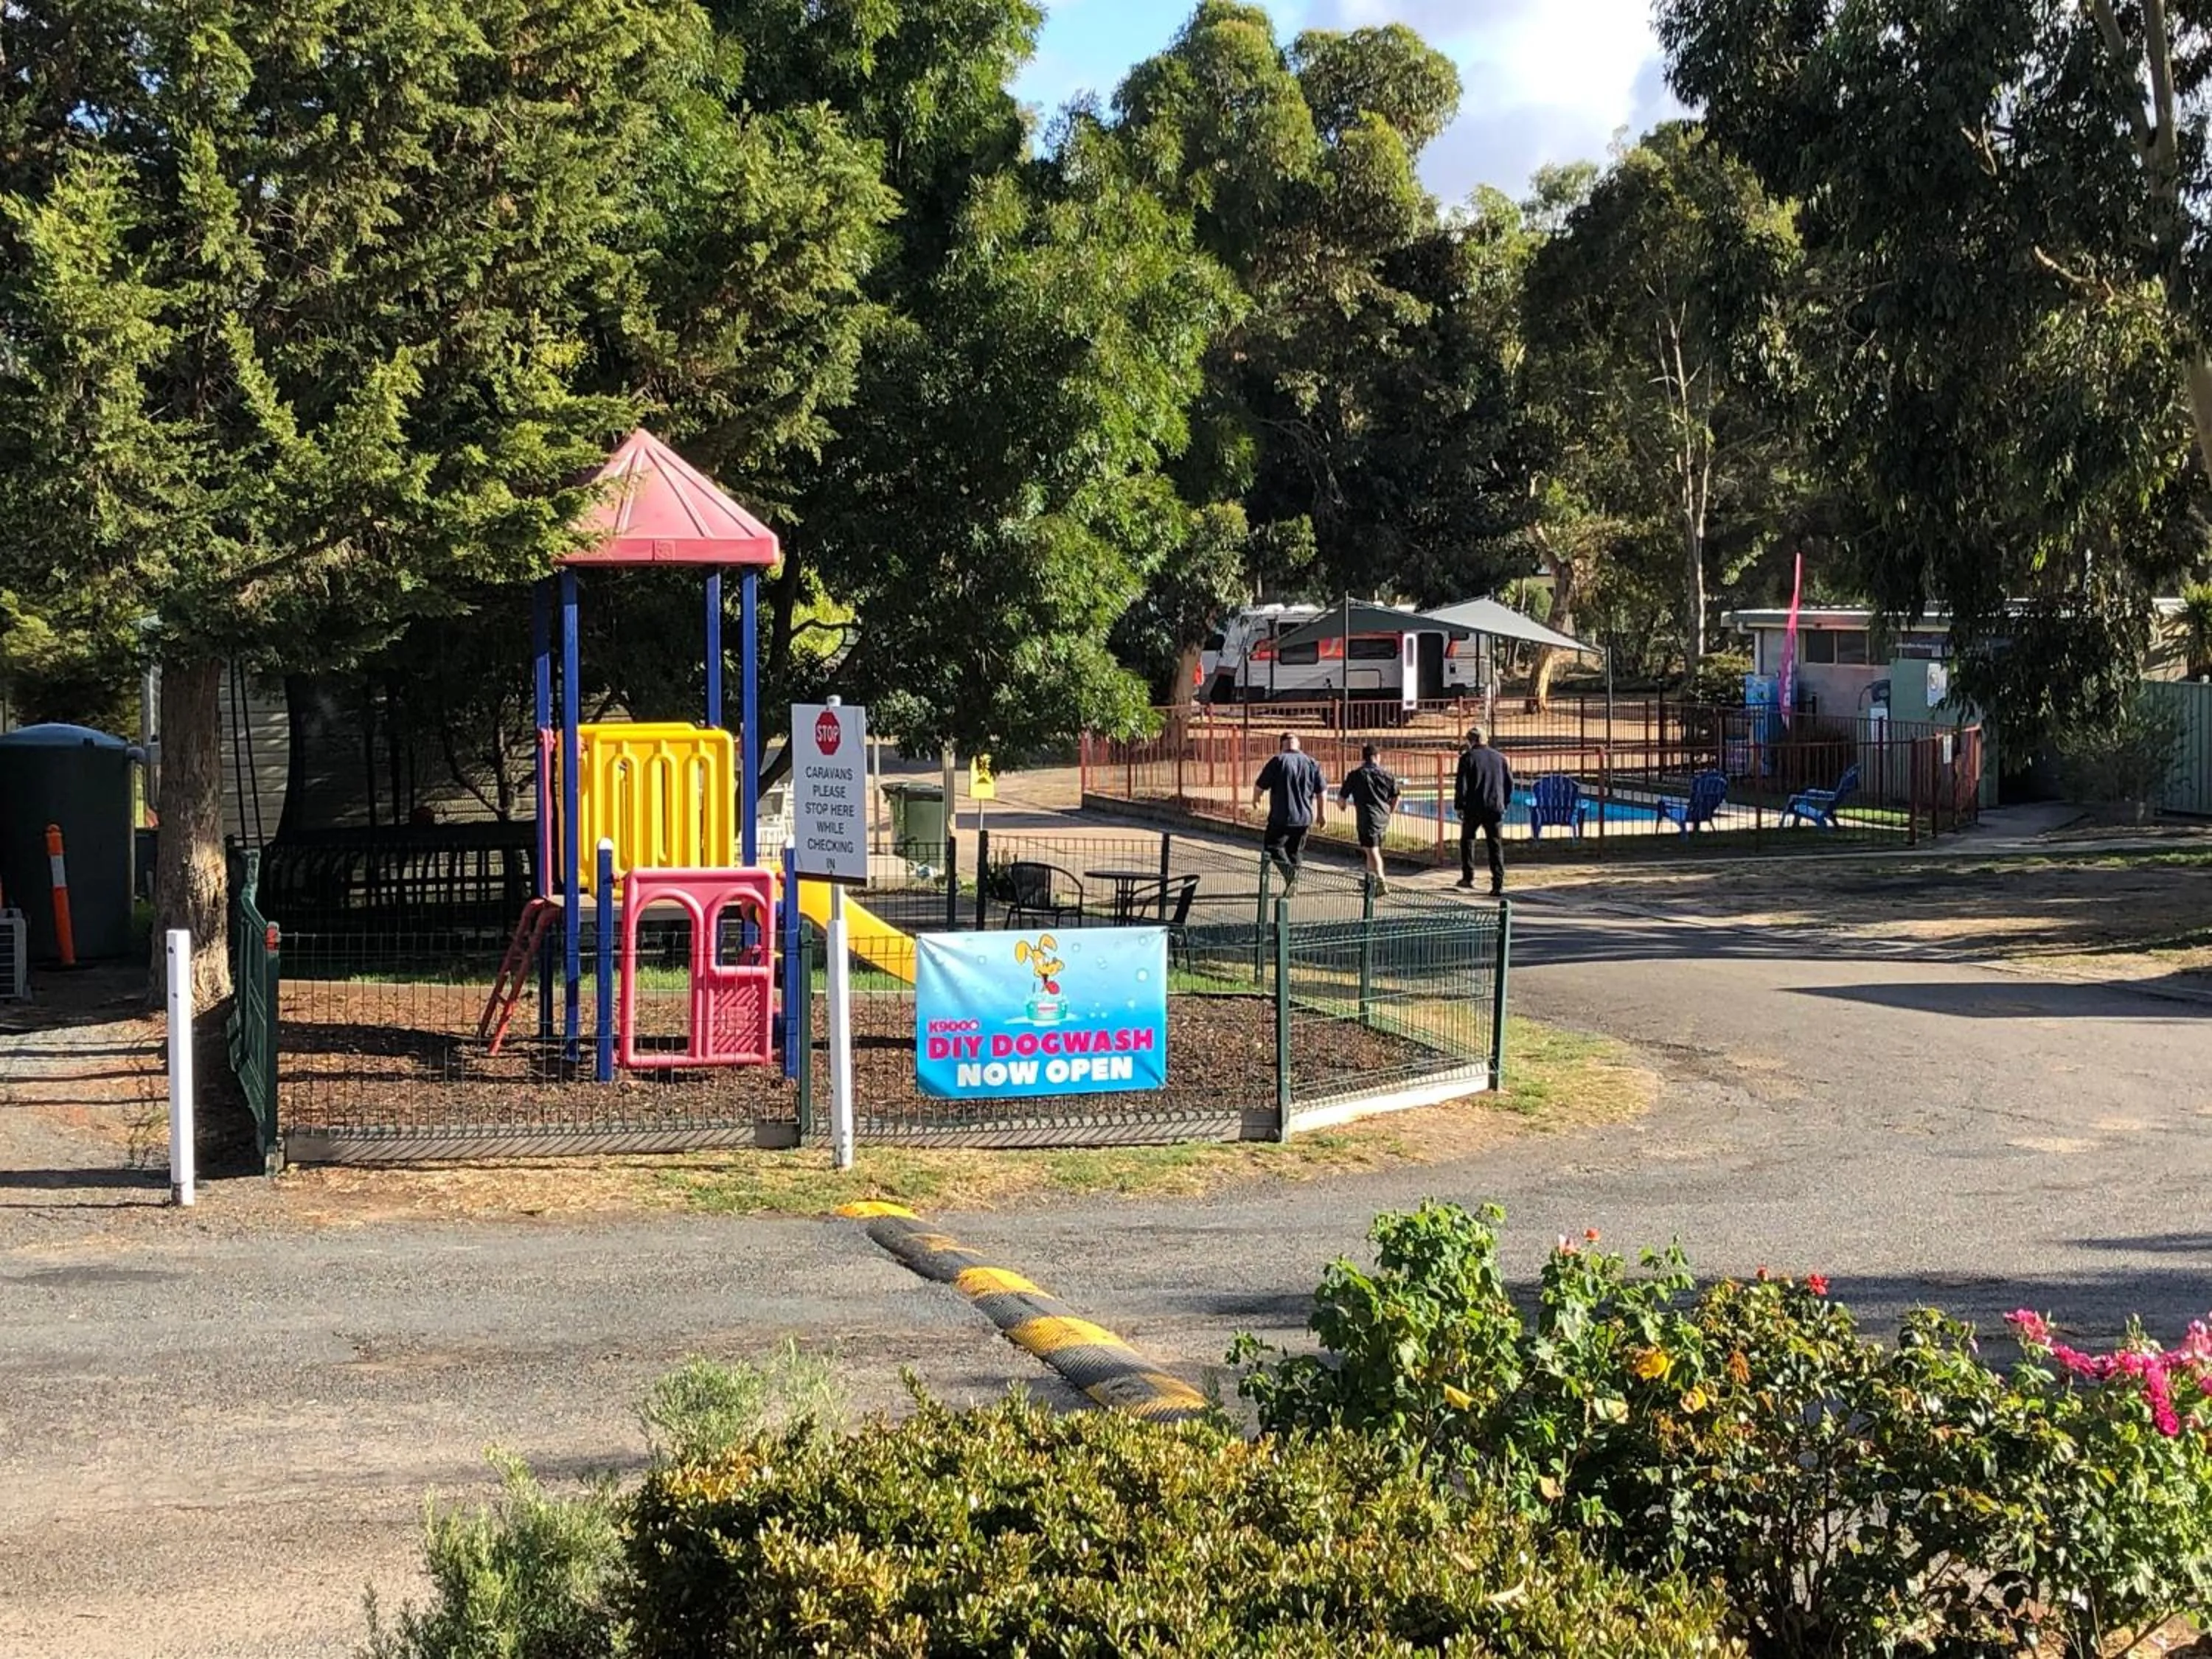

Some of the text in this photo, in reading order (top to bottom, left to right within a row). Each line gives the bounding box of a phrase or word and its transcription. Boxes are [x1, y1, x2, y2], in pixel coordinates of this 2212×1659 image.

[816, 726, 839, 742] STOP
[805, 766, 853, 781] CARAVANS
[813, 785, 846, 799] PLEASE
[805, 801, 855, 817] STOP HERE
[816, 821, 844, 835] WHILE
[807, 838, 854, 854] CHECKING
[827, 858, 835, 869] IN
[928, 1029, 1154, 1060] DIY DOGWASH
[957, 1056, 1133, 1088] NOW OPEN
